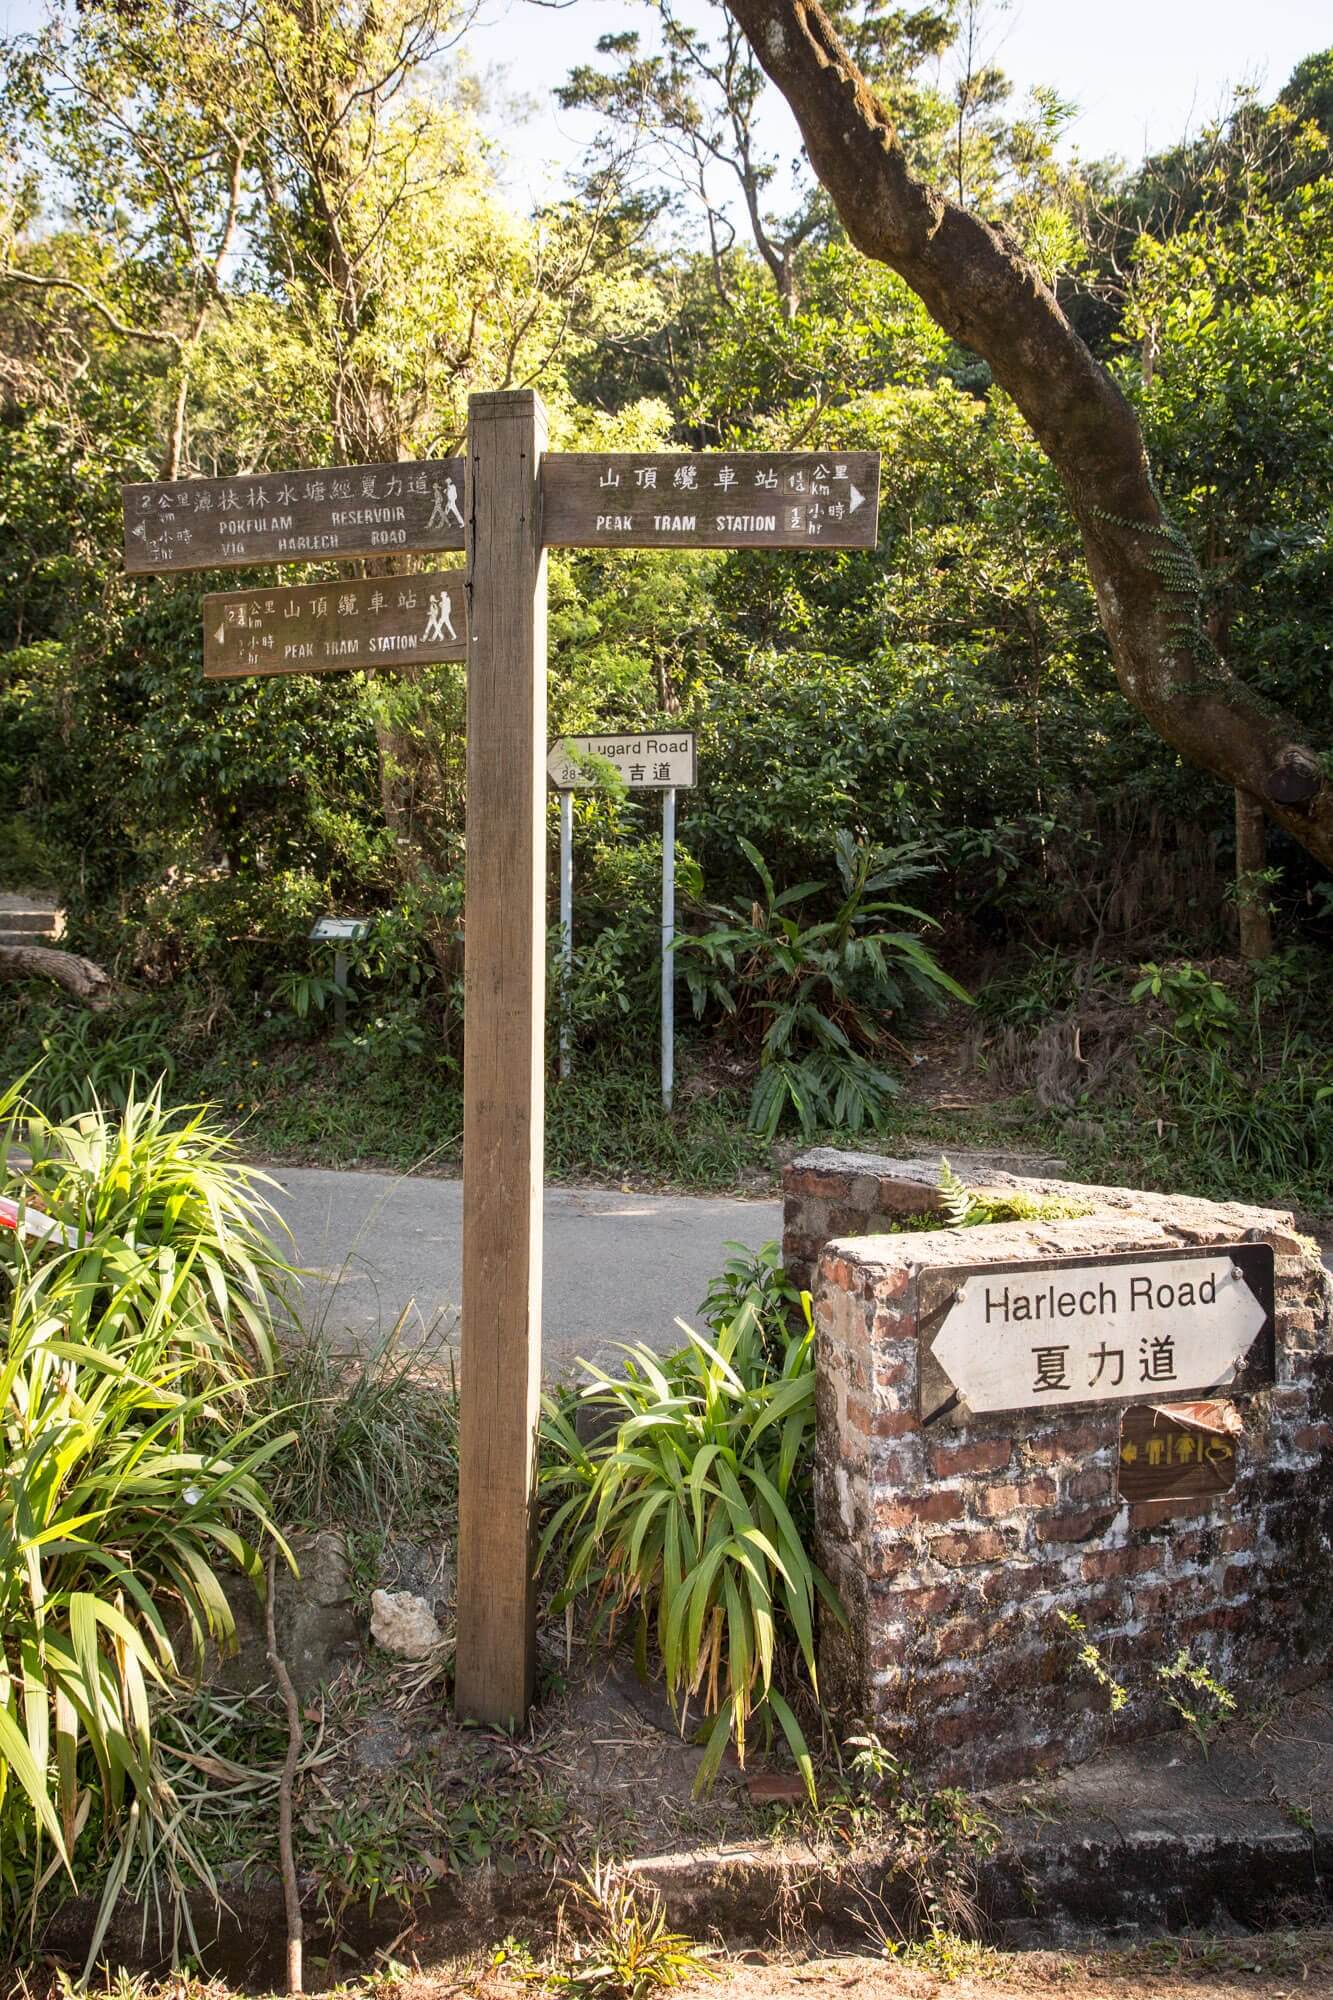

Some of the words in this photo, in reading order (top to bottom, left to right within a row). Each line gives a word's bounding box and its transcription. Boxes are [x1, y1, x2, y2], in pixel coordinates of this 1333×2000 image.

[599, 465, 778, 493] 山頂纜車站
[812, 463, 849, 480] 公里
[811, 481, 830, 496] km
[219, 515, 293, 535] POKFULAM
[331, 506, 406, 527] RESERVOIR
[808, 503, 846, 521] 小時
[597, 516, 632, 531] PEAK
[654, 516, 696, 532] TRAM
[716, 515, 776, 532] STATION
[808, 521, 823, 535] hr
[278, 535, 339, 551] HARLECH
[371, 529, 407, 546] ROAD
[250, 600, 276, 616] 公里
[284, 589, 417, 619] 山頂纜車站
[284, 642, 313, 659] PEAK
[326, 637, 359, 655] TRAM
[369, 634, 418, 652] STATION
[647, 739, 688, 754] Road
[985, 1282, 1117, 1324] Harlech
[1130, 1272, 1217, 1312] Road
[1031, 1334, 1178, 1394] 夏力道
